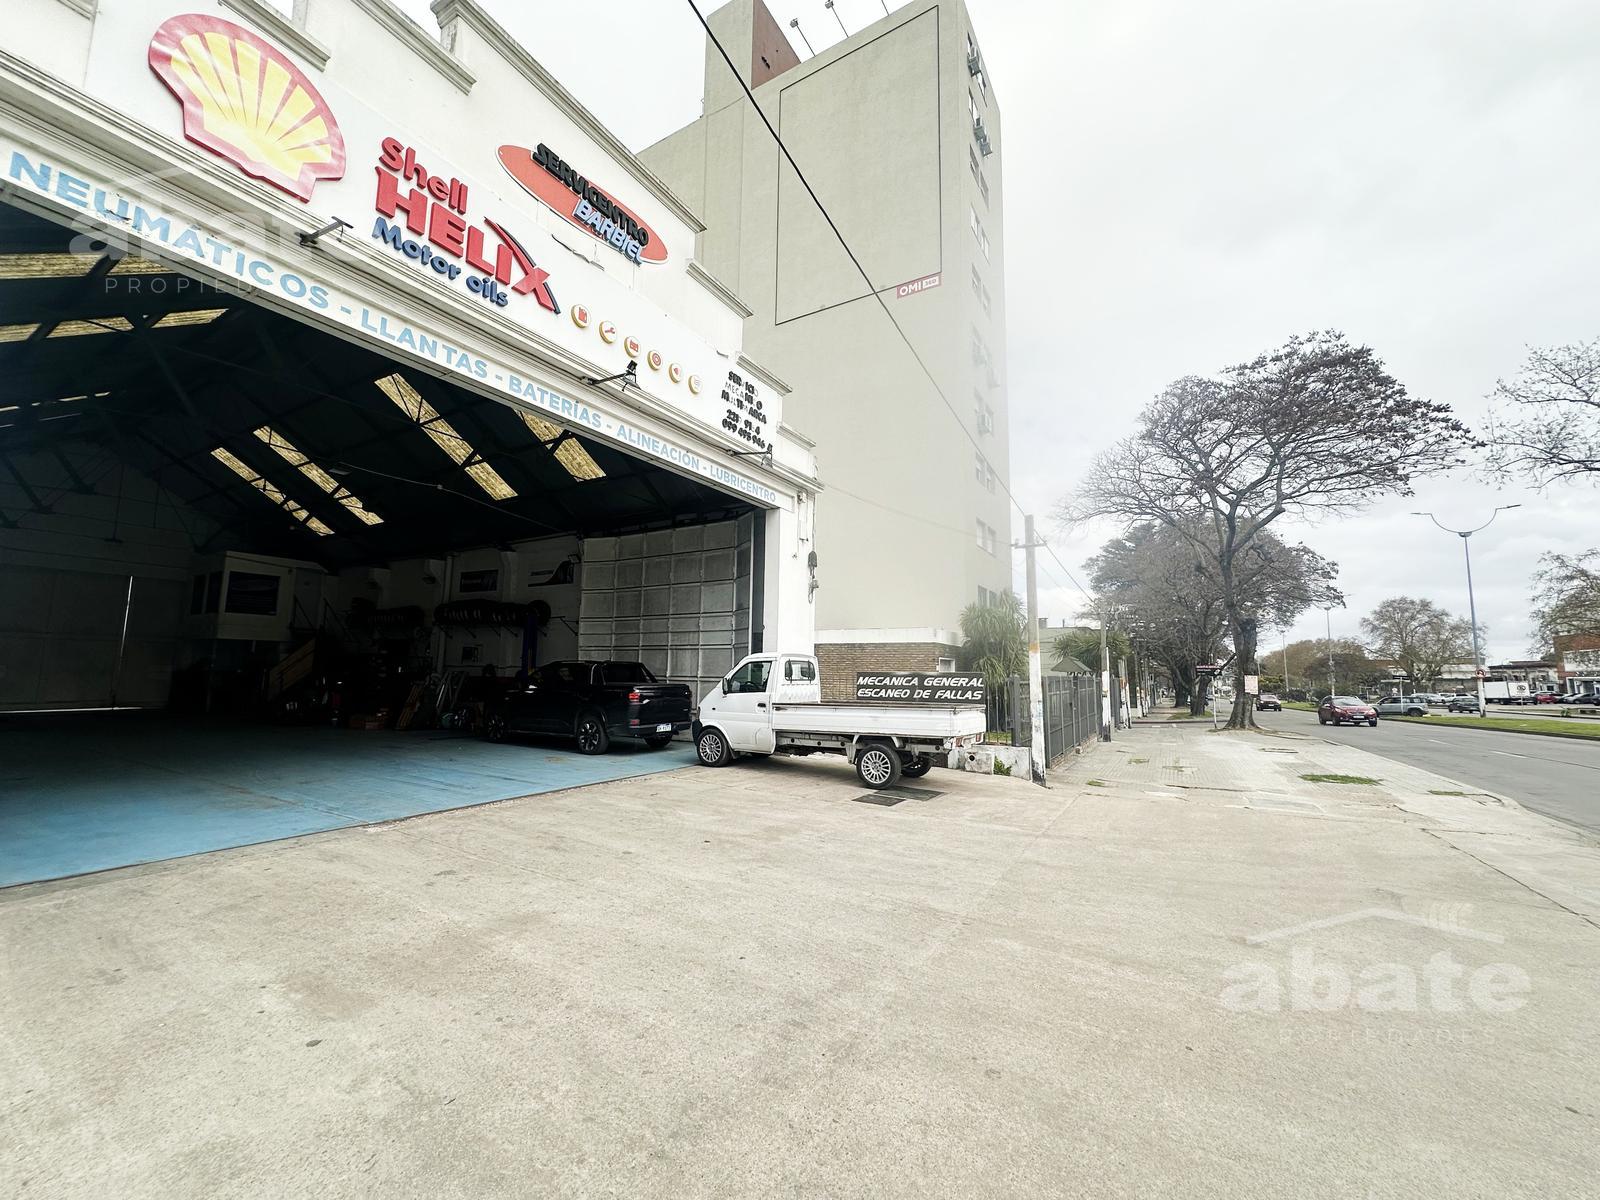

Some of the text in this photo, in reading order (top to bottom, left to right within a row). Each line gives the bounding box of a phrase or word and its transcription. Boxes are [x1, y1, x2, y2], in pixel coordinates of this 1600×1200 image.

[378, 136, 469, 215] Shell
[532, 142, 649, 247] SERVICENTRO
[371, 216, 510, 308] Motor oils
[375, 166, 561, 314] HELIX
[572, 199, 643, 267] BARBIEL
[8, 150, 330, 310] NEUMÁTICOS
[361, 308, 489, 380] LLANTAS
[508, 374, 602, 429] BATERÍAS
[710, 465, 777, 503] LUBRICENTRO
[899, 281, 922, 296] OMI
[857, 676, 984, 687] MECANICA GENERAL
[857, 688, 984, 700] ESCANEO DE FALLAS
